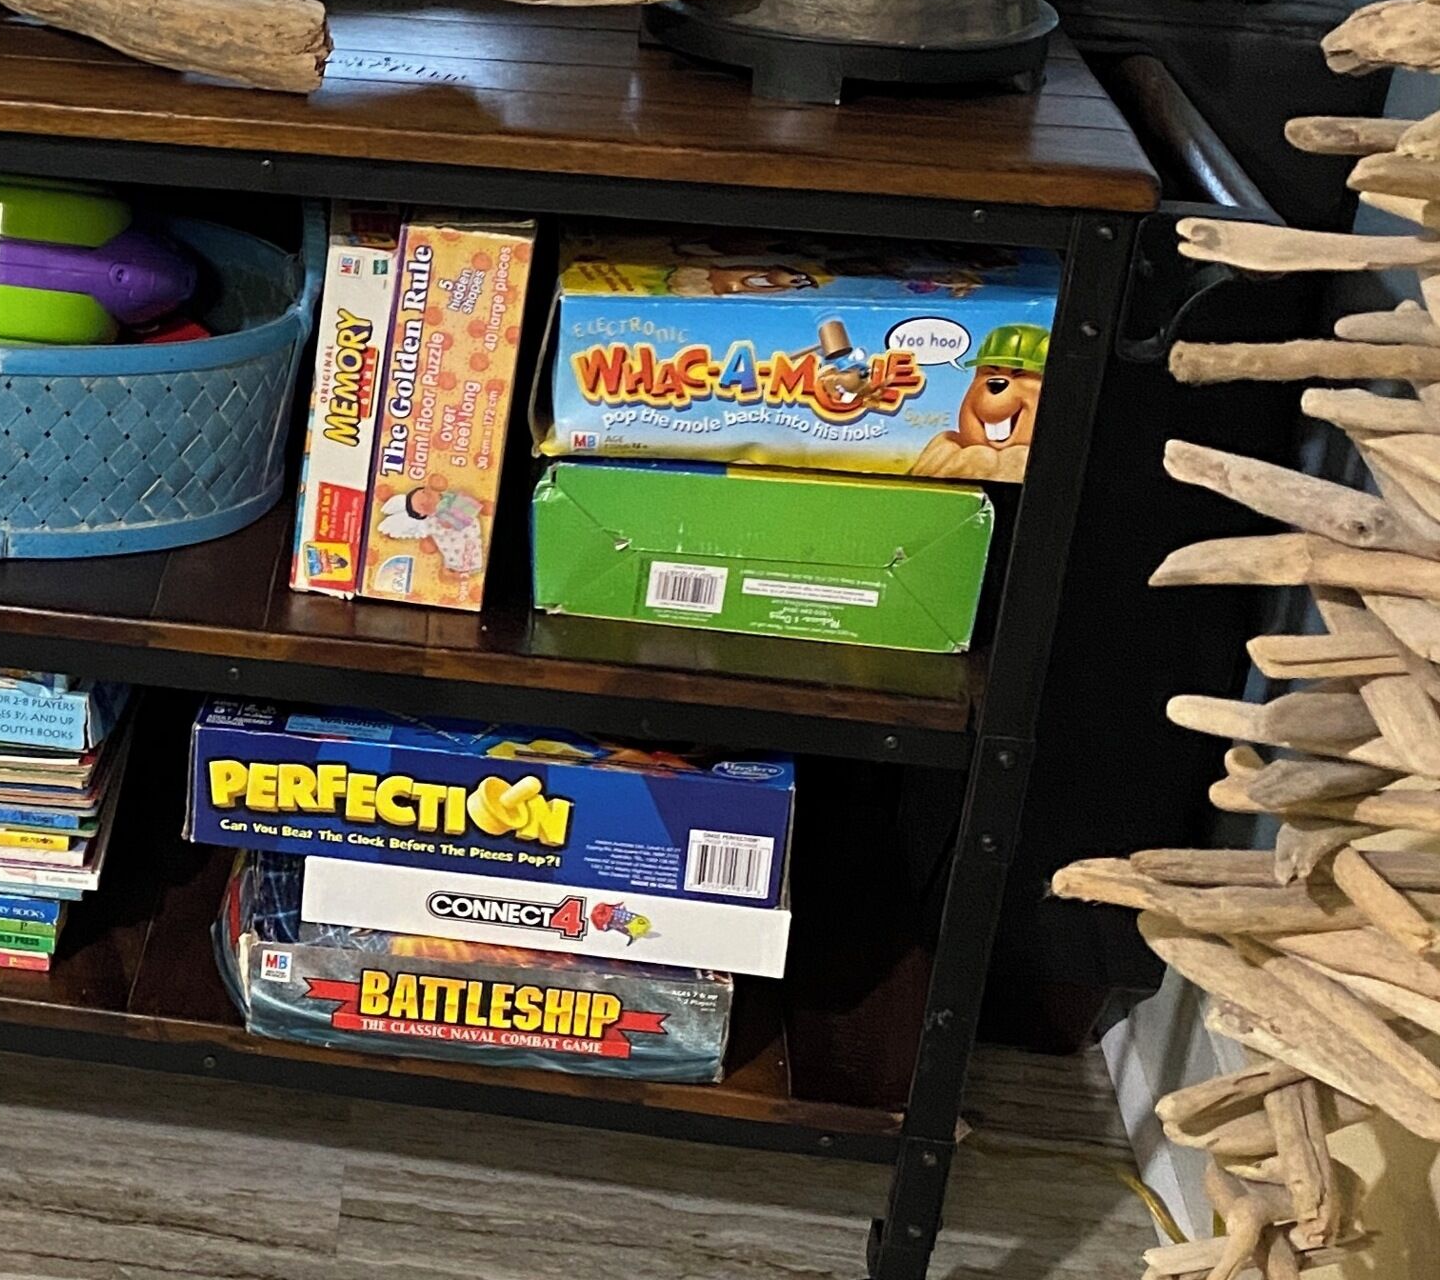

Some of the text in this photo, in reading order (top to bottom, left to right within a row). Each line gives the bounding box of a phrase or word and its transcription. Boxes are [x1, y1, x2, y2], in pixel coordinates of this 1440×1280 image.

[438, 279, 453, 291] 5
[447, 269, 473, 311] hidden
[462, 270, 486, 314] shapes
[484, 246, 511, 351] 40 large pieces
[572, 316, 689, 344] ELECTRONIC
[895, 332, 962, 349] Yoo hoo!
[320, 344, 334, 403] ORIGINAL
[323, 307, 373, 448] MEMORY
[381, 245, 433, 475] The Golden Rule
[361, 357, 374, 405] GAME
[489, 390, 498, 407] cm
[409, 332, 444, 480] Giant Floor Puzzle
[440, 406, 457, 442] over
[451, 381, 481, 467] 5 feet long
[601, 408, 889, 442] pop the mole back into his hole!
[573, 434, 597, 448] MB
[13, 697, 29, 706] 2-8
[31, 699, 75, 711] PLAYERS
[30, 713, 57, 723] AND
[60, 716, 74, 725] UP
[37, 726, 73, 739] BOOKS
[209, 759, 571, 847] PERFECTION
[220, 819, 561, 868] Can You Beat The Clock Before The Pieces Pop?!
[12, 906, 45, 919] BOOKS
[431, 895, 583, 936] CONNECT 4
[266, 955, 288, 969] MB
[360, 969, 622, 1038] BATTLESHIP
[361, 1019, 603, 1054] THE CLASSIC NAVAL COMBAT GAME
